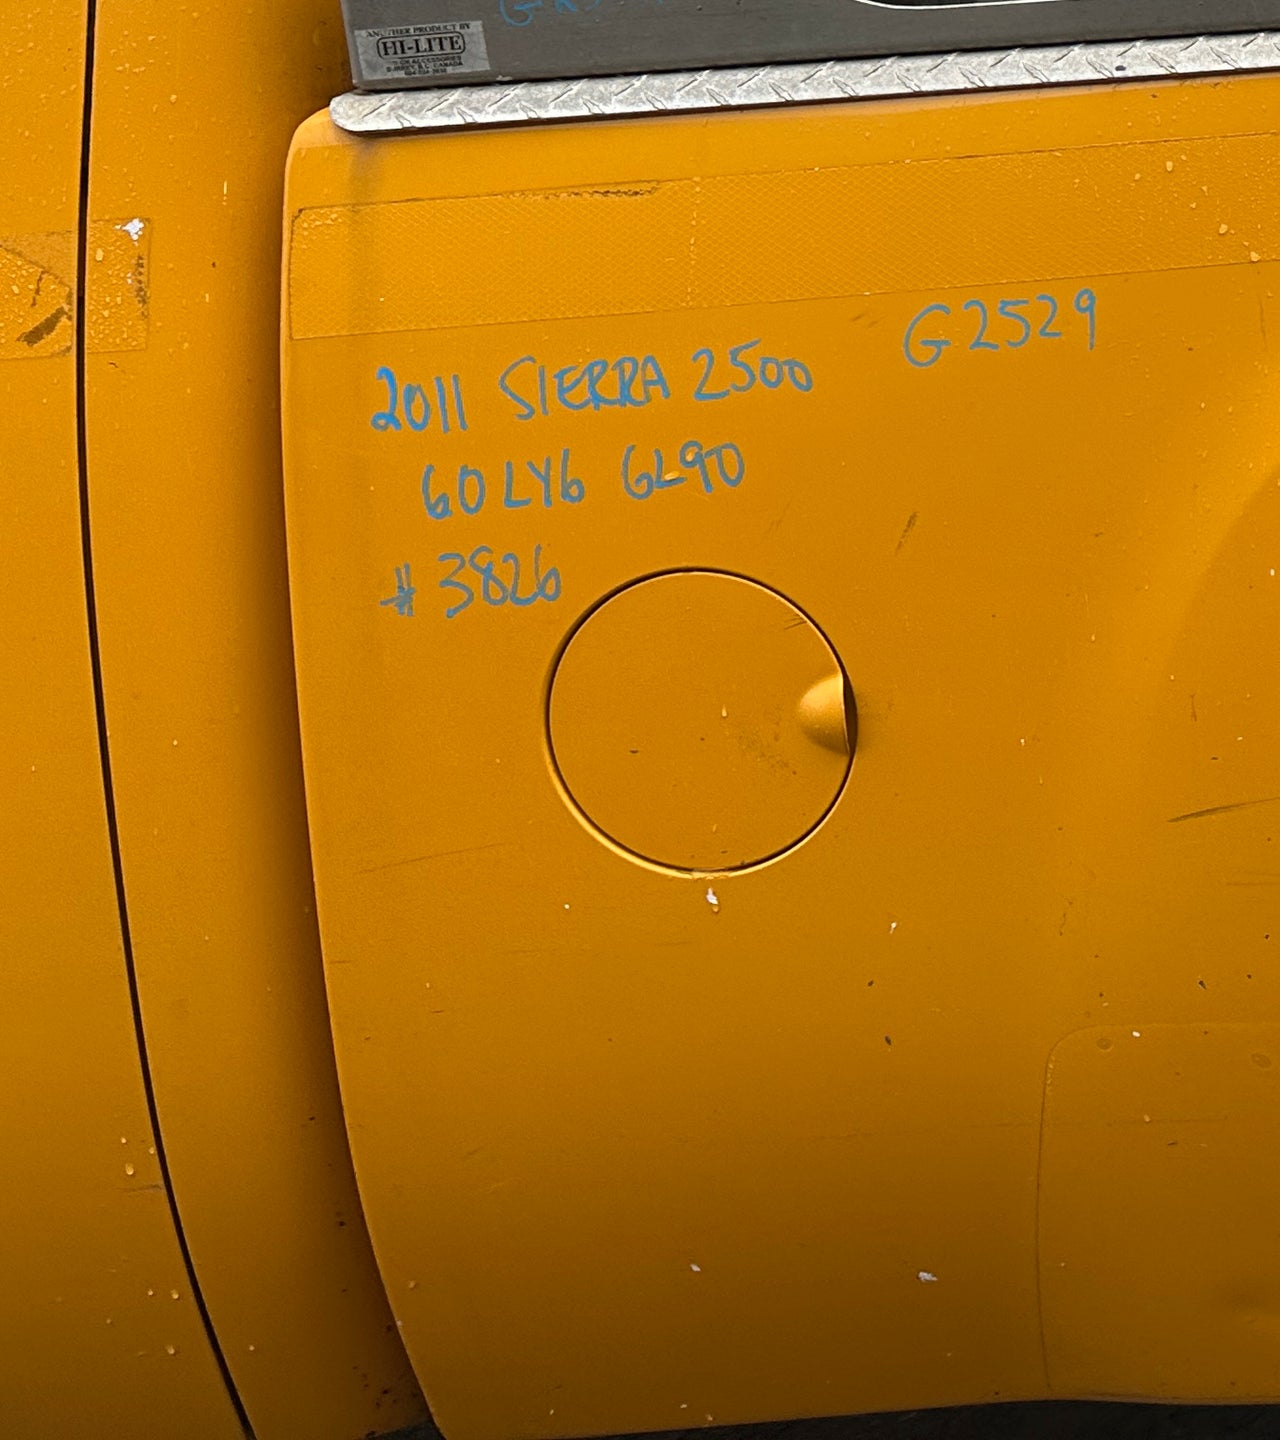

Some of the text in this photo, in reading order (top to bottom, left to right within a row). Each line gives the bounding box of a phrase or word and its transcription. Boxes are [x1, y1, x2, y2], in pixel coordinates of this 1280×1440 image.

[381, 35, 462, 56] HI-LITE
[904, 288, 1097, 367] G2529
[371, 341, 813, 432] 2011 SIERRA 2500
